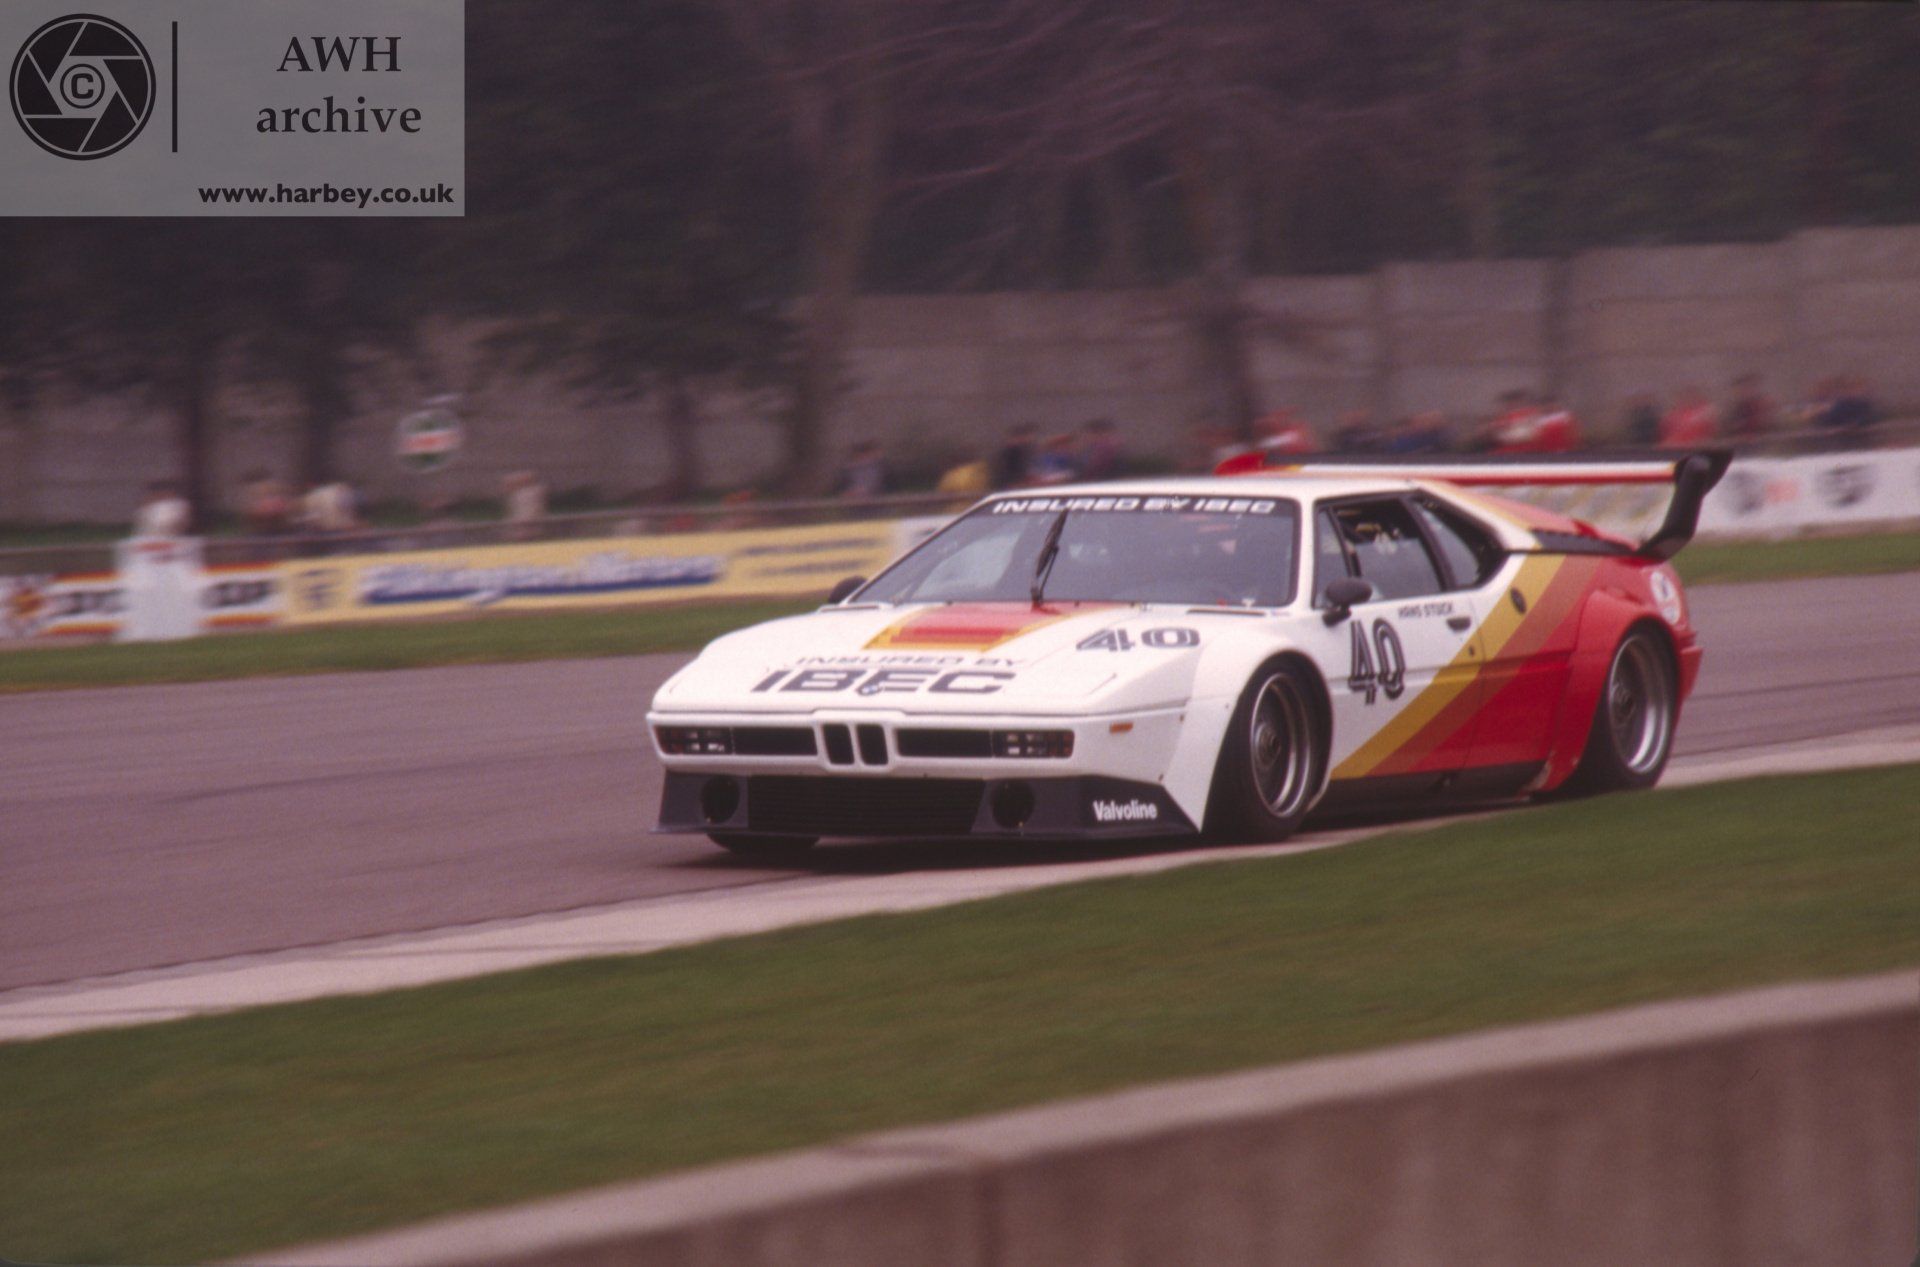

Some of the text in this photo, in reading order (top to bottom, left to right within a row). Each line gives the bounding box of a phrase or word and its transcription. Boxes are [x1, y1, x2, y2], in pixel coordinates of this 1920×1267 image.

[993, 498, 1139, 514] INSURED
[1076, 627, 1200, 652] 40
[1347, 618, 1405, 704] 40
[751, 669, 1017, 695] IBEC
[1092, 799, 1158, 821] Valvoline
